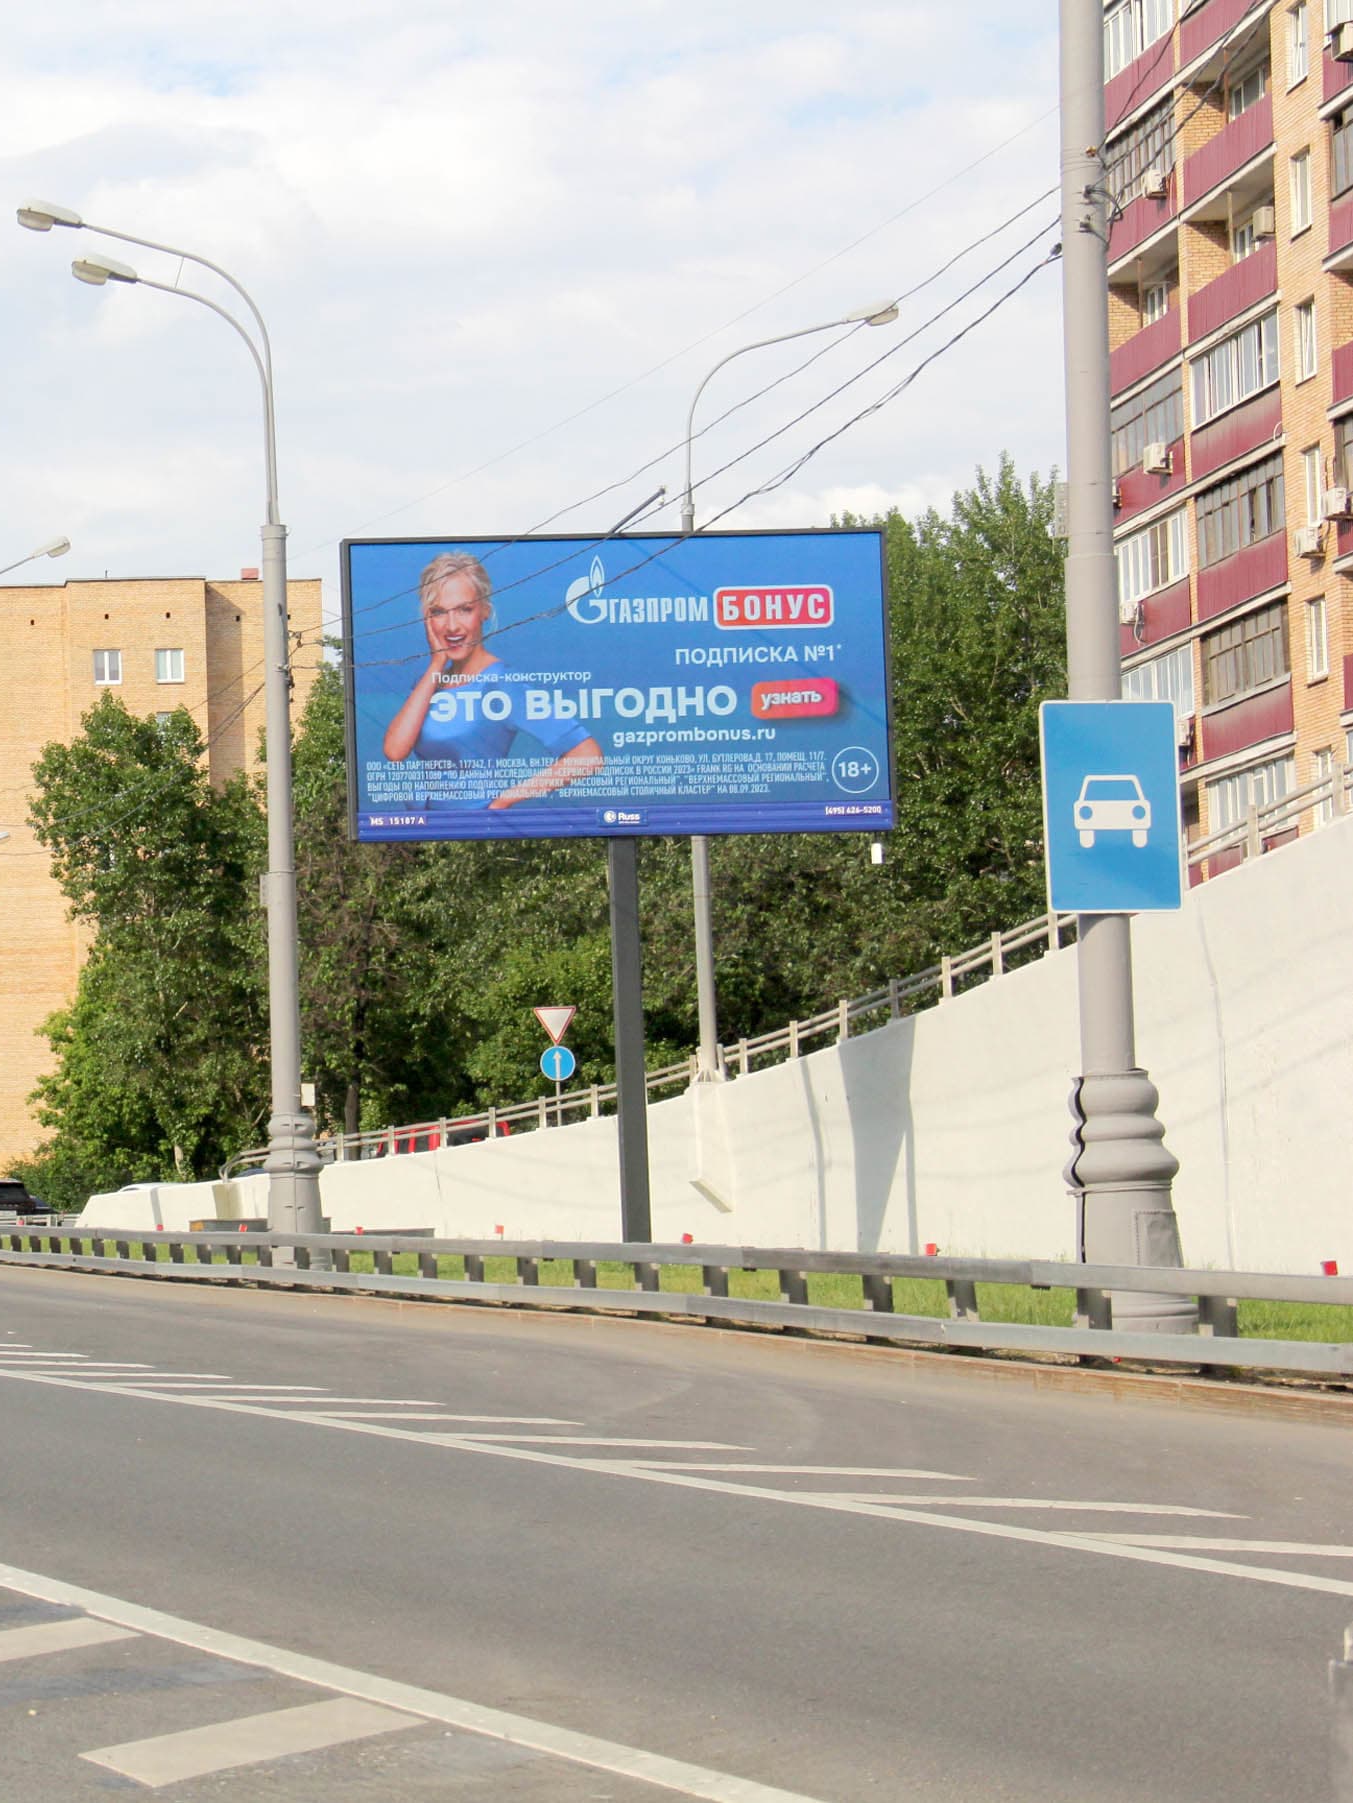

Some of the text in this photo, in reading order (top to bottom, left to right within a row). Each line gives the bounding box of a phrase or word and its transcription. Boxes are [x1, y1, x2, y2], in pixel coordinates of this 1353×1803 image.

[608, 593, 825, 625] ГАЗПРОМ БОНУС
[674, 645, 799, 668] ПОДПИСКА
[431, 670, 592, 685] Подписка-конструктор
[428, 685, 738, 724] ЭТО ВЫГОДНО
[759, 689, 823, 711] узнать
[612, 726, 777, 748] gazprombonus.ru
[366, 760, 382, 771] ООО
[631, 754, 655, 765] ОКРУГ
[367, 771, 386, 782] ОГРН
[459, 769, 492, 781] ДАННЫМ
[594, 765, 635, 777] ПОДПИСОК
[636, 765, 642, 775] В
[643, 764, 672, 775] РОССИИ
[696, 763, 721, 774] FRANK
[722, 763, 733, 773] RG
[734, 763, 745, 773] НА
[747, 761, 792, 773] ОСНОВАНИИ
[793, 761, 825, 772] РАСЧЕТА
[838, 760, 872, 778] 18+
[367, 781, 400, 793] ВЫГОДЫ
[402, 781, 413, 792] ПО
[414, 780, 466, 791] НАПОЛНЕНИЮ
[467, 779, 508, 790] ПОДПИСОК
[630, 784, 676, 796] СТОЛИЧНЫЙ
[717, 784, 728, 794] НА
[417, 816, 425, 825] A
[617, 811, 641, 821] Russ
